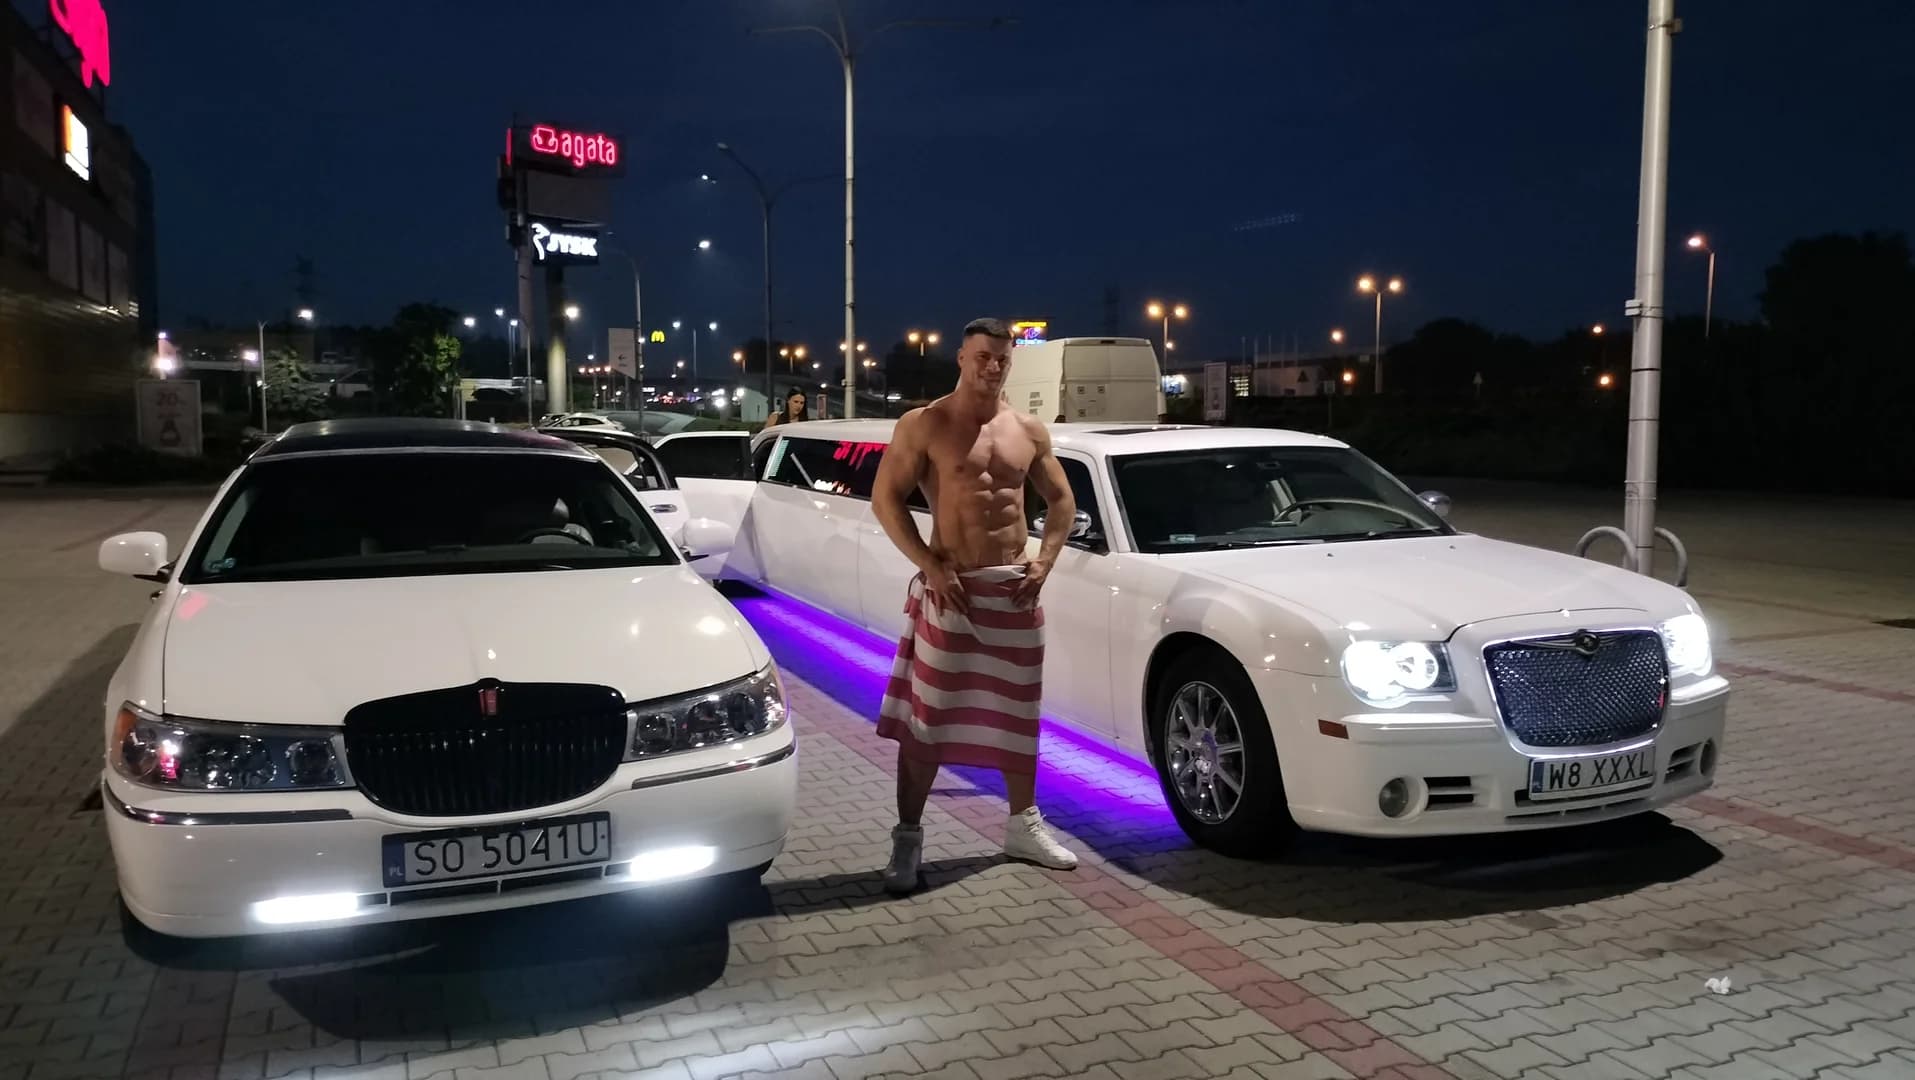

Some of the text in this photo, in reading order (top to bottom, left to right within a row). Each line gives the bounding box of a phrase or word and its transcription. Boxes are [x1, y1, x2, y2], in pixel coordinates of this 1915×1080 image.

[561, 133, 617, 167] agata
[546, 233, 598, 257] JYSK
[1550, 751, 1649, 790] W8 XXXL
[414, 821, 599, 876] SO 5041U
